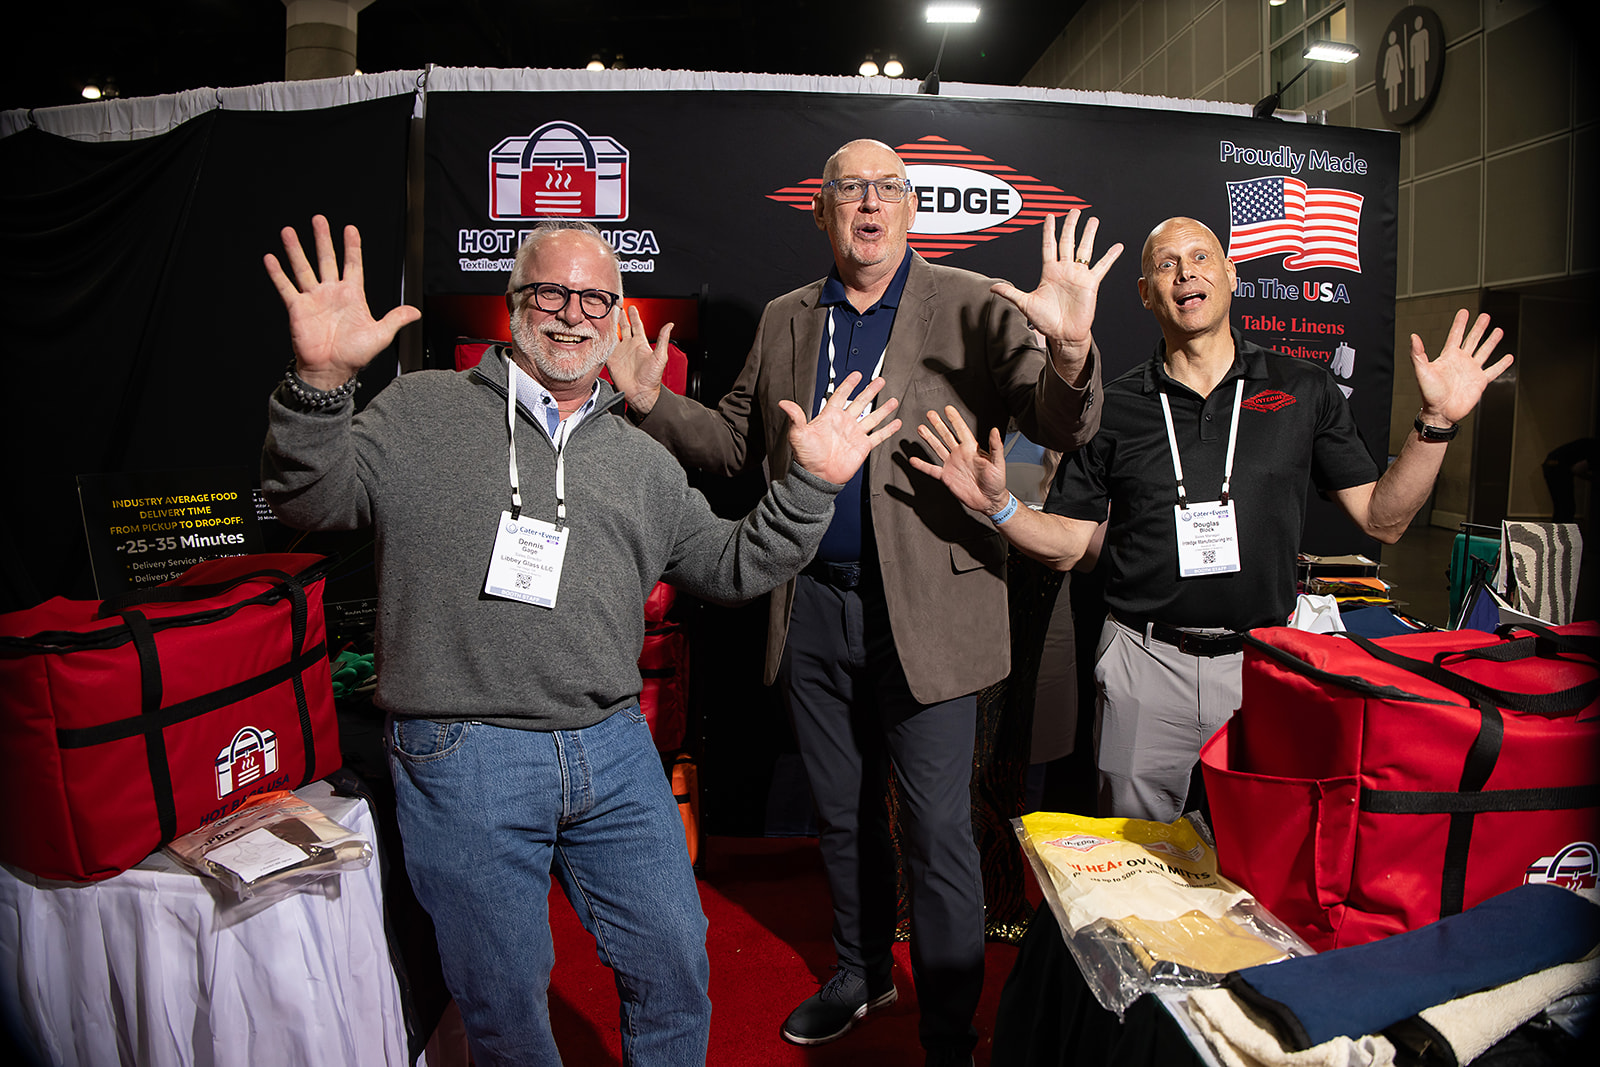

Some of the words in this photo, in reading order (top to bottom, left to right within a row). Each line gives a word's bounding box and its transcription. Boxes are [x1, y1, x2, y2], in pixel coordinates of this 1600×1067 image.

[1220, 140, 1306, 174] Proudly
[1309, 149, 1368, 175] Made
[911, 186, 1010, 215] EDGE
[459, 229, 515, 254] HOT
[602, 229, 660, 255] USA
[459, 258, 498, 271] Textiles
[631, 259, 654, 271] Soul
[1234, 277, 1255, 298] In
[1258, 278, 1299, 300] The
[1303, 281, 1350, 304] USA
[1241, 314, 1287, 333] Table
[1291, 317, 1345, 336] Linens
[1281, 345, 1332, 363] Delivery
[112, 497, 163, 509] INDUSTRY
[165, 493, 210, 505] AVERAGE
[210, 491, 238, 502] FOOD
[139, 507, 186, 519] DELIVERY
[187, 505, 212, 516] TIME
[110, 524, 140, 535] FROM
[142, 521, 178, 533] PICKUP
[179, 519, 194, 530] TO
[195, 516, 244, 528] DROP-OFF:
[1193, 521, 1219, 529] Douglas
[116, 536, 177, 554] ~25-35
[180, 531, 245, 549] Minutes
[518, 538, 544, 550] Dennis
[521, 546, 538, 555] Gage
[132, 558, 167, 570] Delivery
[167, 555, 198, 567] Service
[501, 554, 521, 565] Libbey
[522, 559, 540, 569] Glass
[540, 564, 554, 573] LLC
[135, 571, 169, 583] Delivery
[199, 804, 228, 827] HOT
[267, 774, 290, 791] USA
[1166, 864, 1211, 880] MITTS
